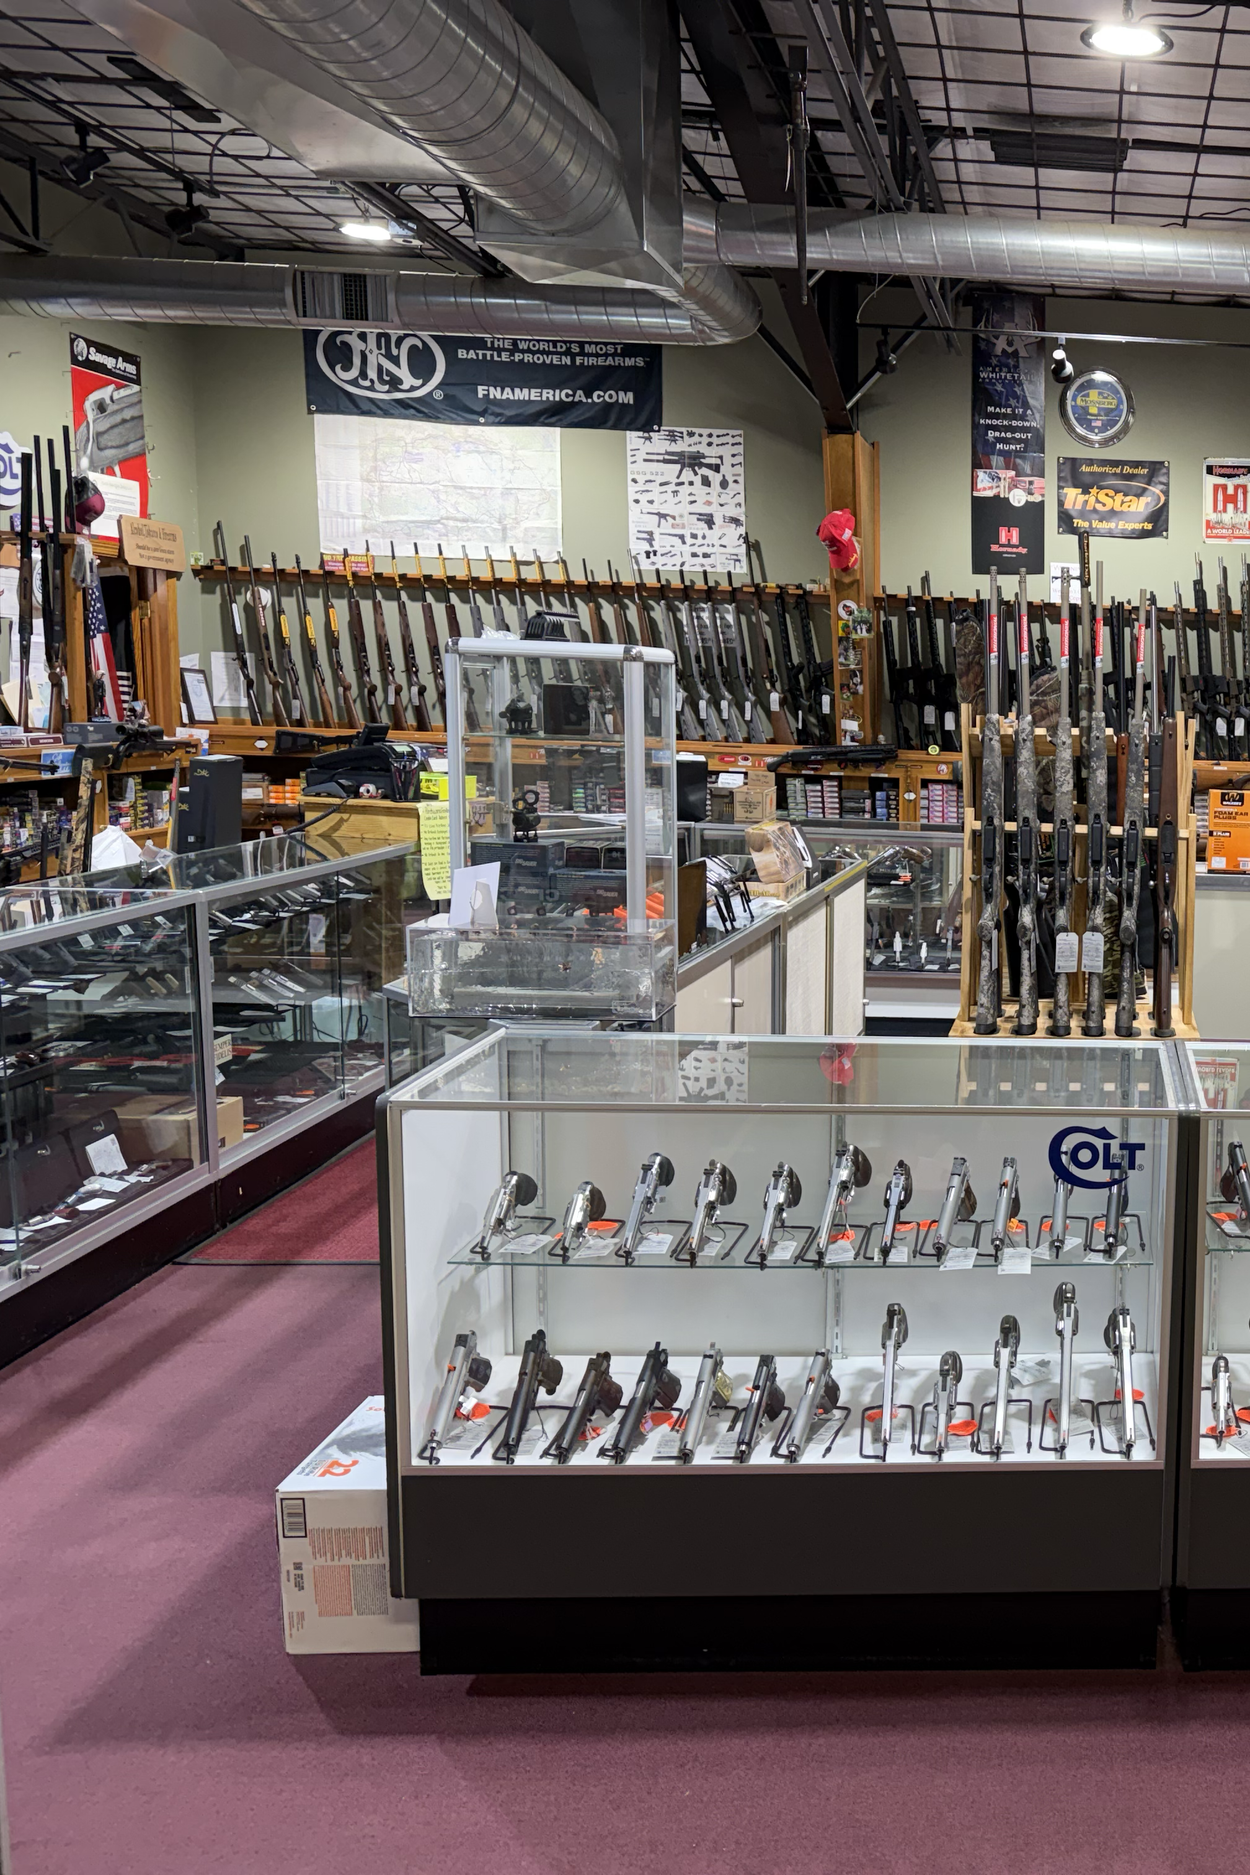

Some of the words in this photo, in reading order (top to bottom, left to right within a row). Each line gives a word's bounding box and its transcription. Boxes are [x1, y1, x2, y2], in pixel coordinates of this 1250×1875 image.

[485, 338, 514, 349] THE
[517, 340, 580, 353] WORLD'S
[584, 343, 624, 354] MOST
[88, 347, 116, 369] Savage
[117, 357, 137, 375] Arms
[457, 349, 570, 364] BATTLE-PROVEN
[477, 385, 635, 404] FNAMERICA.COM
[1079, 463, 1122, 474] Authorized
[1123, 464, 1149, 475] Dealer
[1063, 486, 1152, 512] TriStar
[1072, 519, 1089, 529] The
[1092, 519, 1116, 529] Value
[1118, 520, 1153, 530] Experts
[1048, 1125, 1146, 1190] COLT
